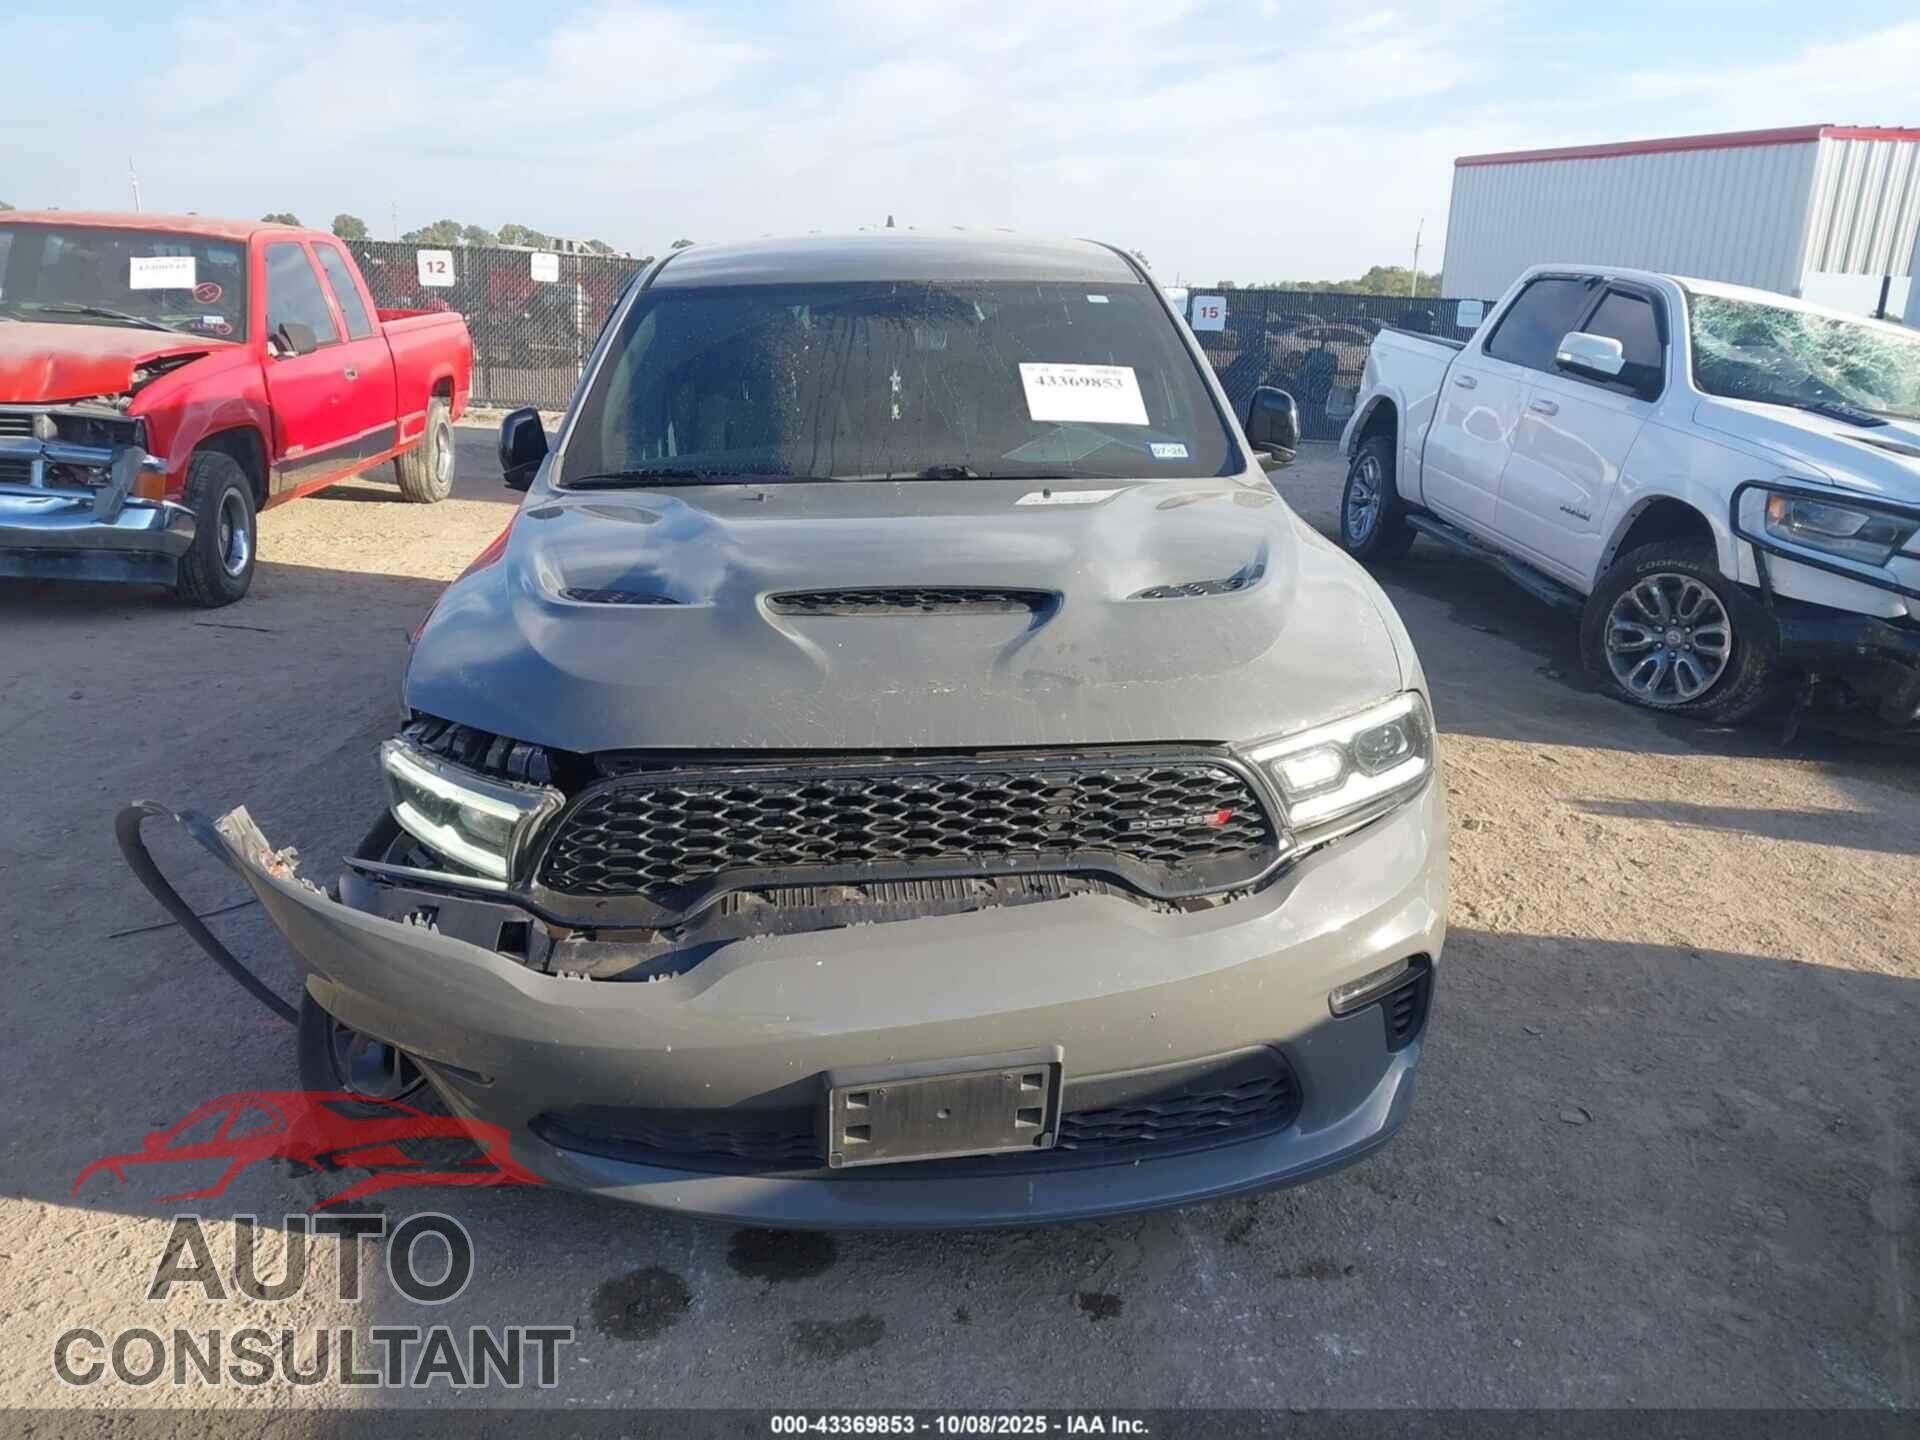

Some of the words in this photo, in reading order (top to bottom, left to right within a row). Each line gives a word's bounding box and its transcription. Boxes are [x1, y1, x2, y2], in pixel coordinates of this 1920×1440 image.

[426, 260, 446, 274] 12
[1200, 306, 1219, 319] 15
[1034, 375, 1124, 389] 43369853
